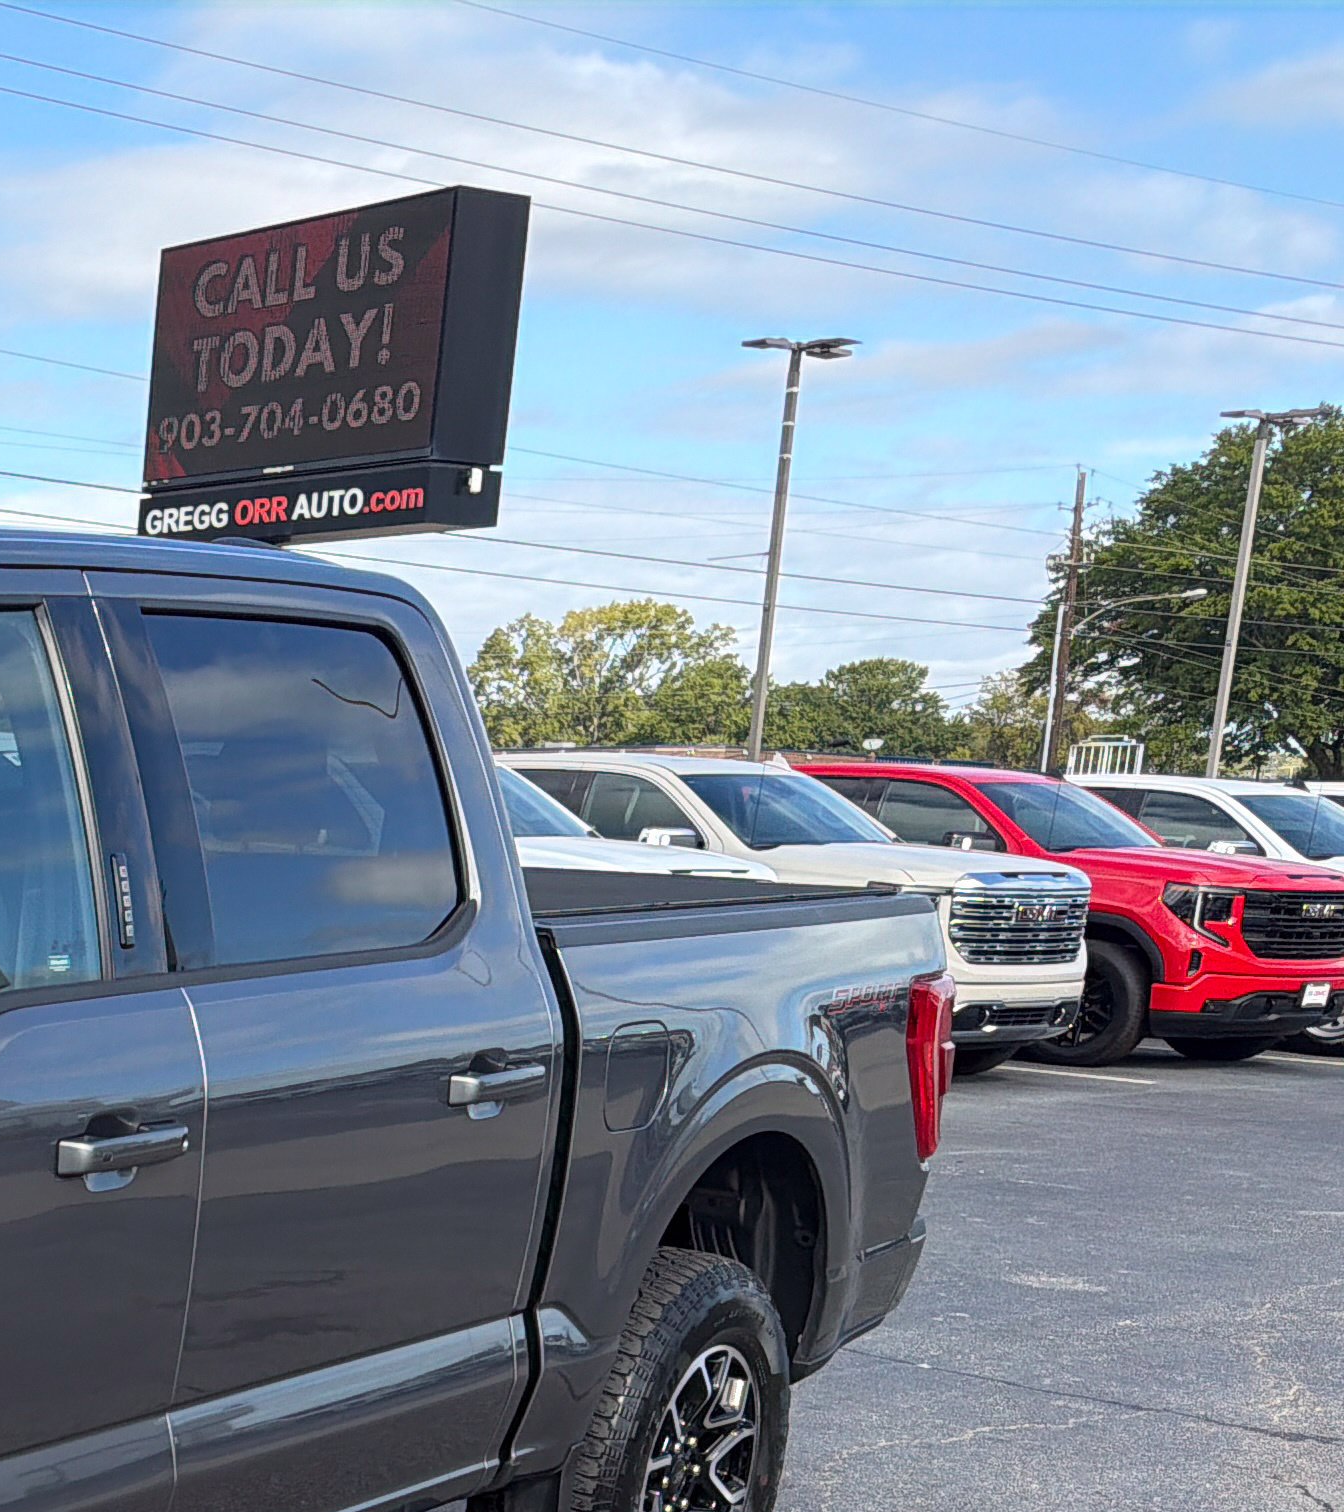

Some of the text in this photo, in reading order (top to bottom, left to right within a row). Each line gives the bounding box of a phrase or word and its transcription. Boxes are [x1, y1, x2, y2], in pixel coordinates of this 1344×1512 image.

[193, 226, 405, 318] CALL US
[192, 303, 395, 392] TODAY!
[158, 380, 421, 453] 903-704-0680
[145, 486, 425, 535] GREGG ORR AUTO.com
[827, 982, 908, 1016] SPORT
